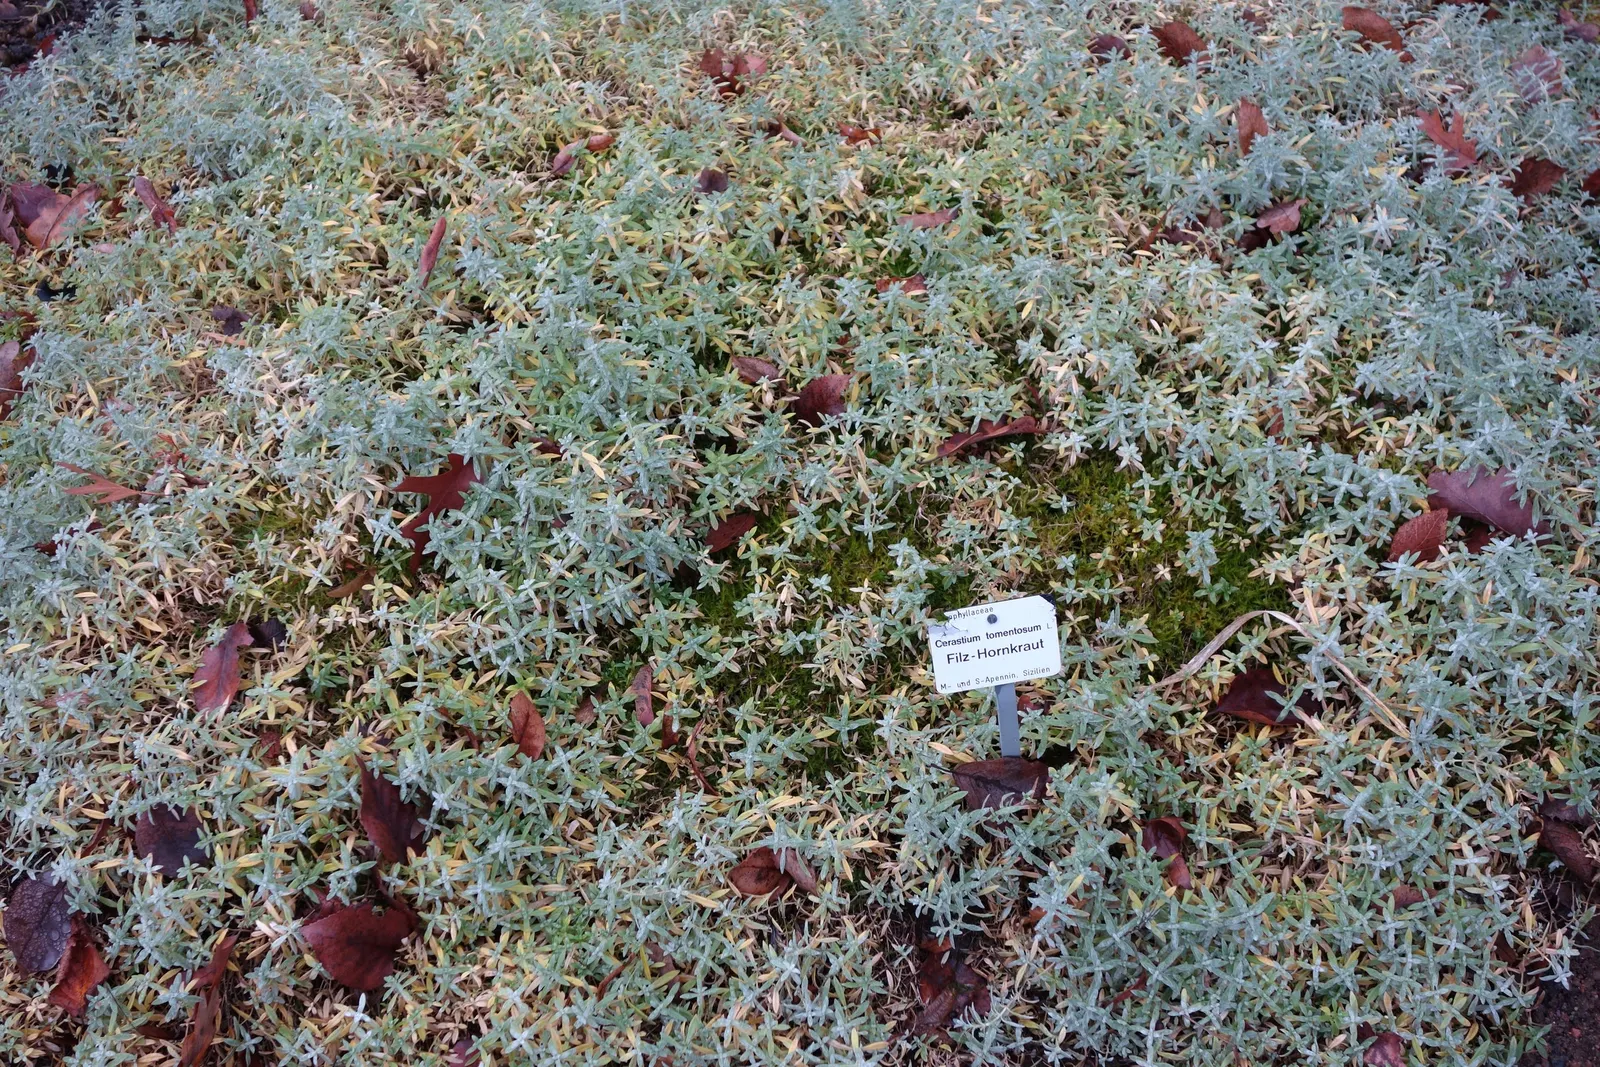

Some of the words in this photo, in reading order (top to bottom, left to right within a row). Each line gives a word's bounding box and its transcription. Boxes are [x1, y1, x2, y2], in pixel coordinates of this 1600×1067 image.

[935, 634, 981, 648] Cerastium
[985, 623, 1042, 640] tomentosum
[946, 638, 1045, 665] Filz-Hornkraut
[940, 683, 952, 691] M-
[956, 680, 971, 688] und
[1022, 666, 1051, 677] Sizilien
